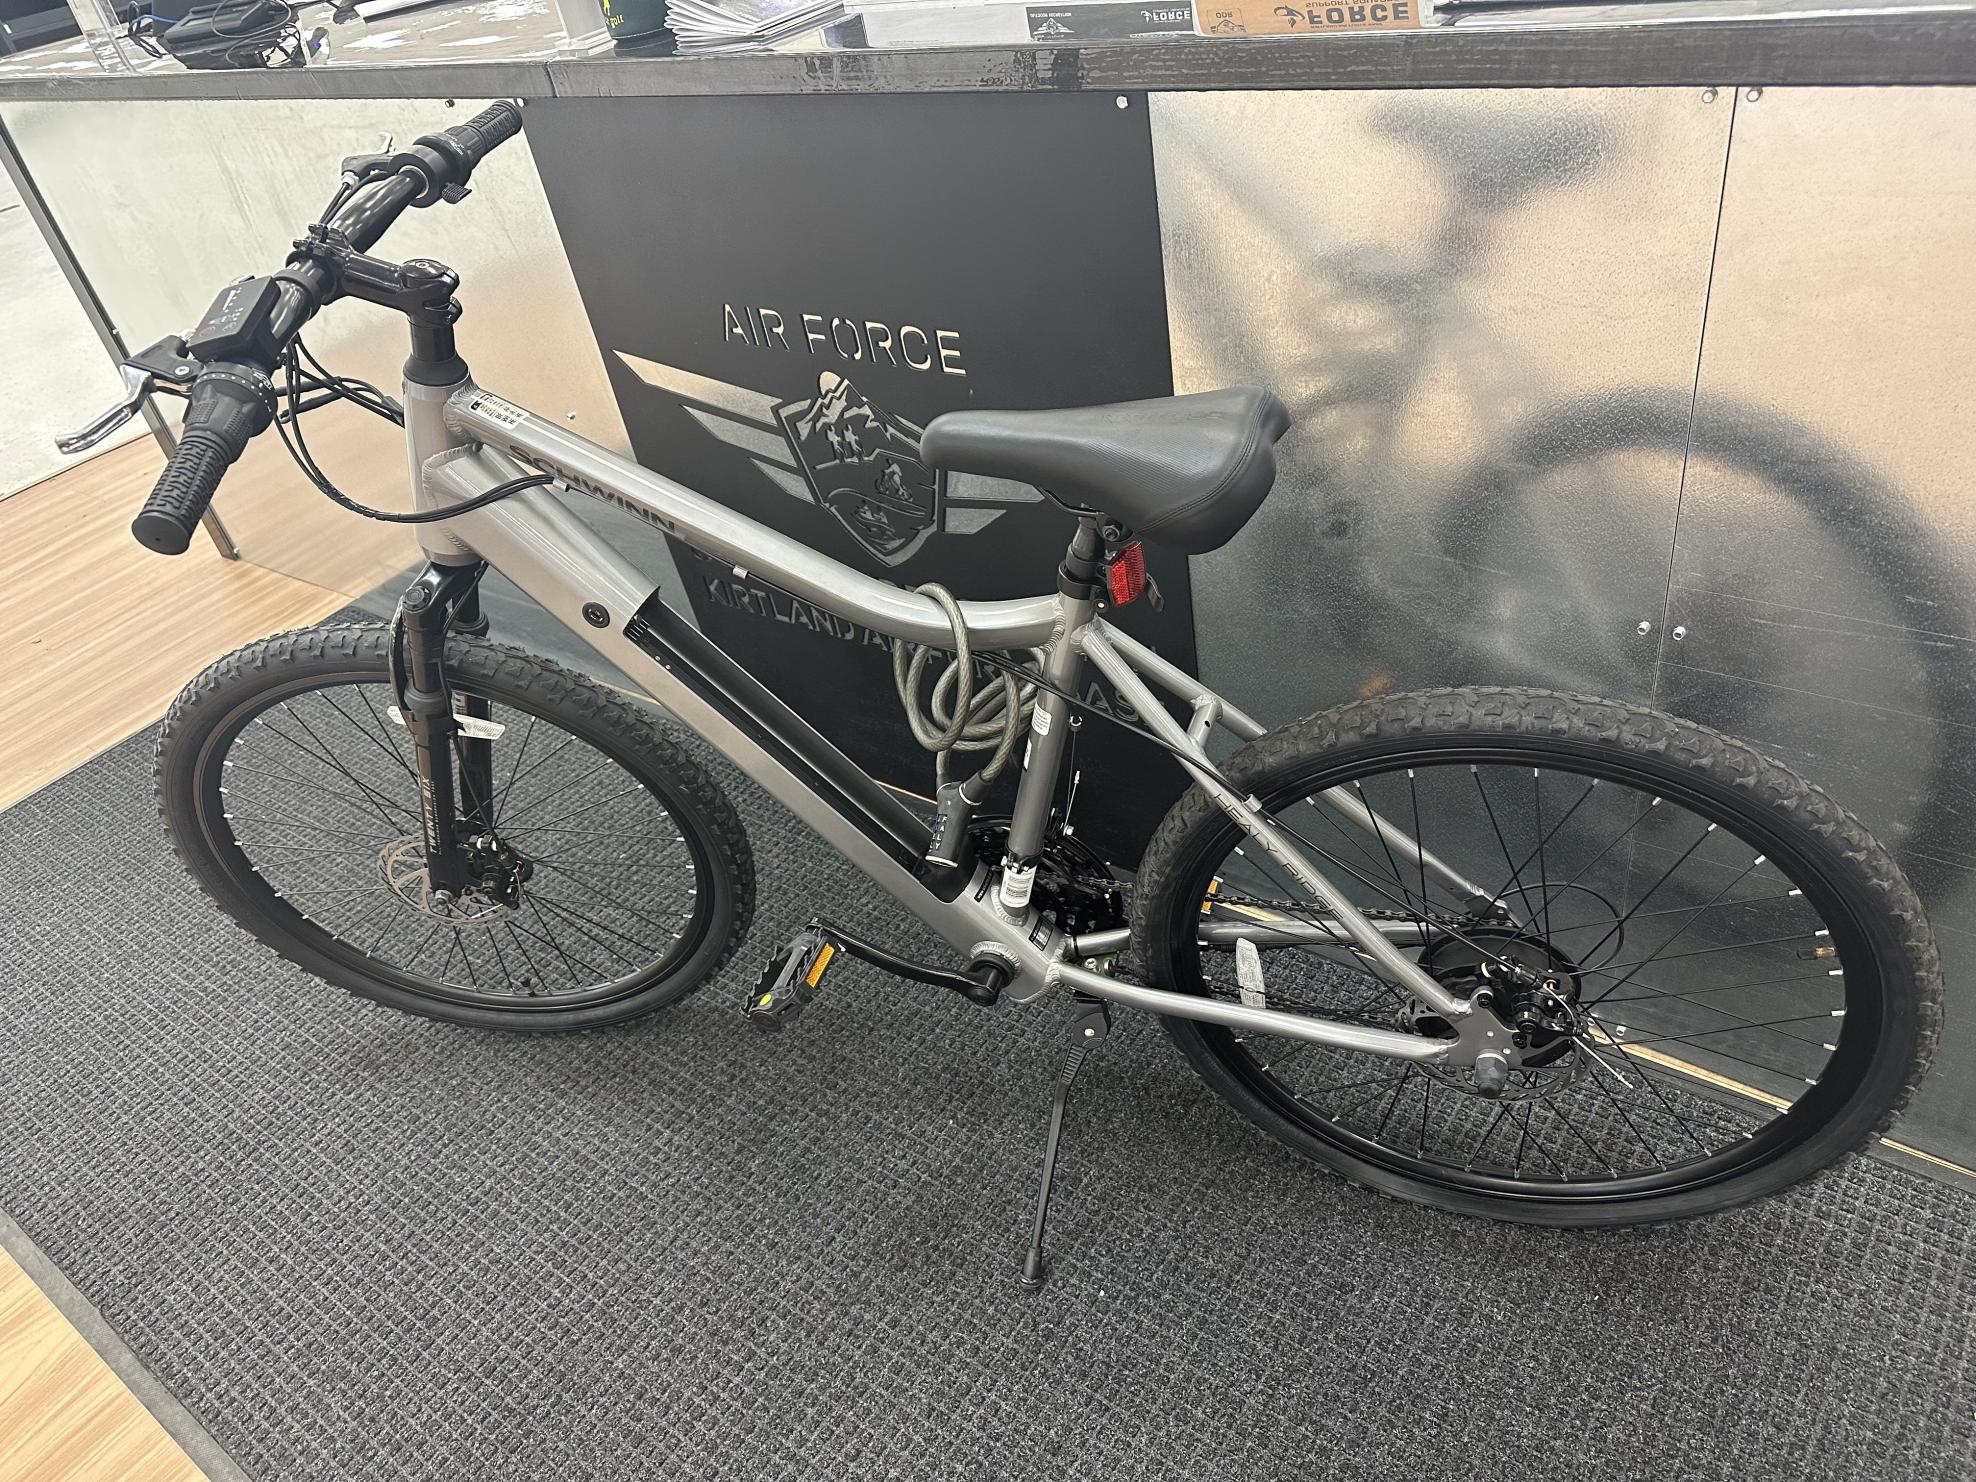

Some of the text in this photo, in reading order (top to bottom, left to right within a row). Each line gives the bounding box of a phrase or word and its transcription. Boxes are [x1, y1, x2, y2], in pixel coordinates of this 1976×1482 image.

[722, 303, 967, 376] AIR FORCE
[702, 576, 855, 641] KIRTLAND
[421, 775, 432, 799] SIX
[424, 802, 438, 854] TWENTY
[1213, 792, 1343, 920] HEALY RIDGE
